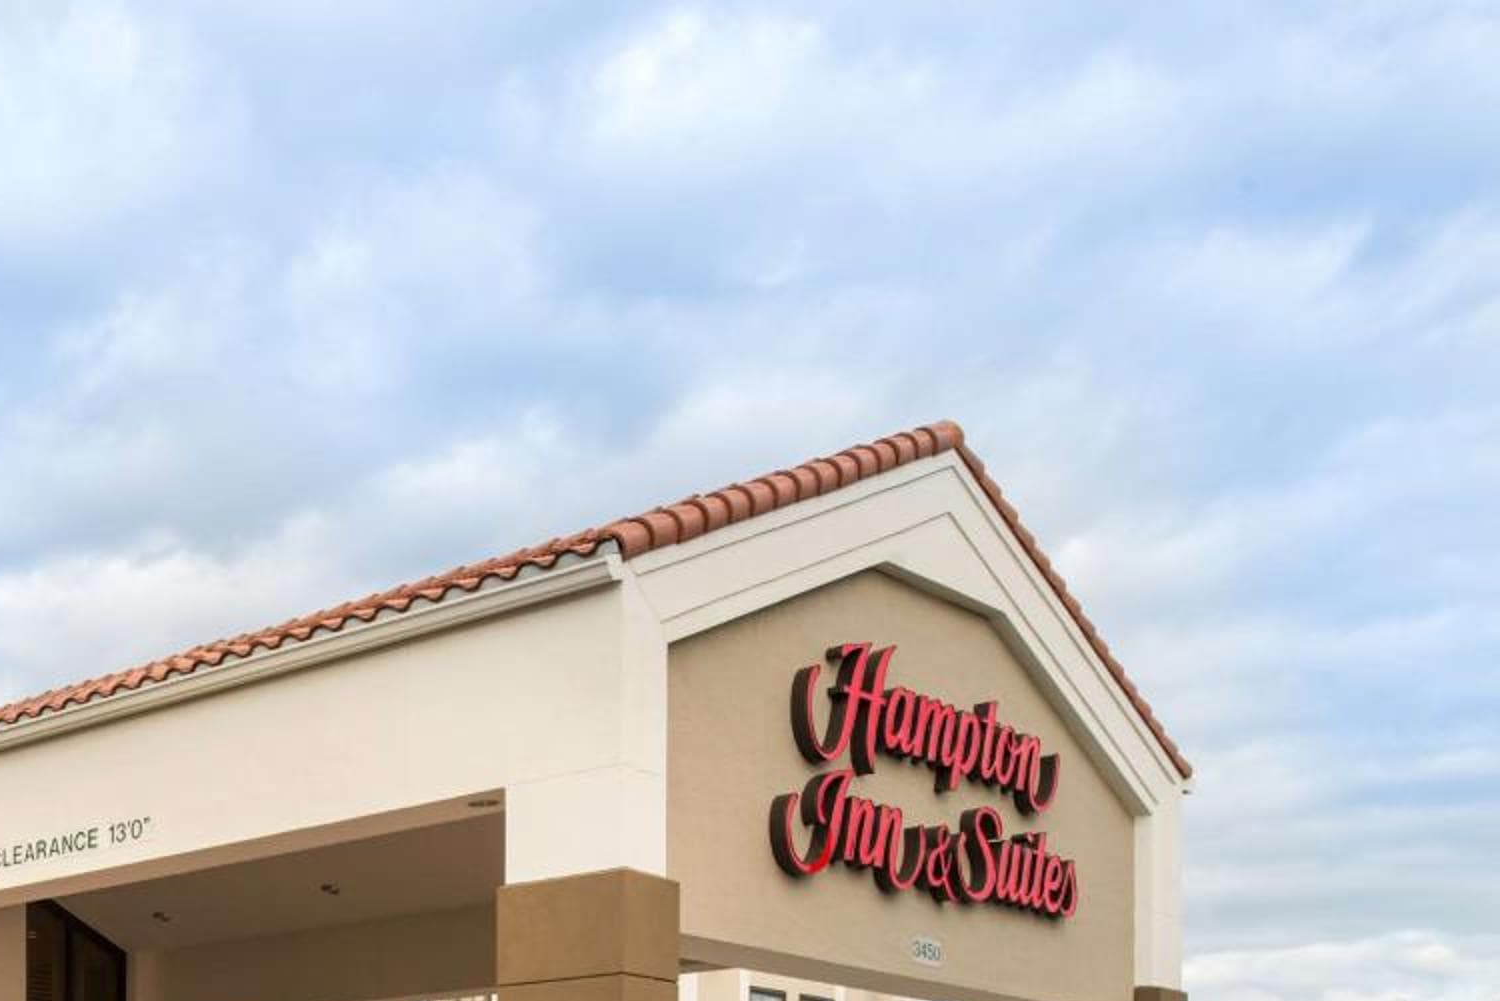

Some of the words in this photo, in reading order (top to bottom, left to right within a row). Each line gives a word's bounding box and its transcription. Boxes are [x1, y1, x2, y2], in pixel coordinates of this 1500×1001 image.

[793, 641, 1060, 814] Hampton
[773, 768, 927, 891] Inn
[926, 825, 959, 903] &
[957, 806, 1078, 919] Suites
[911, 939, 942, 961] 3450
